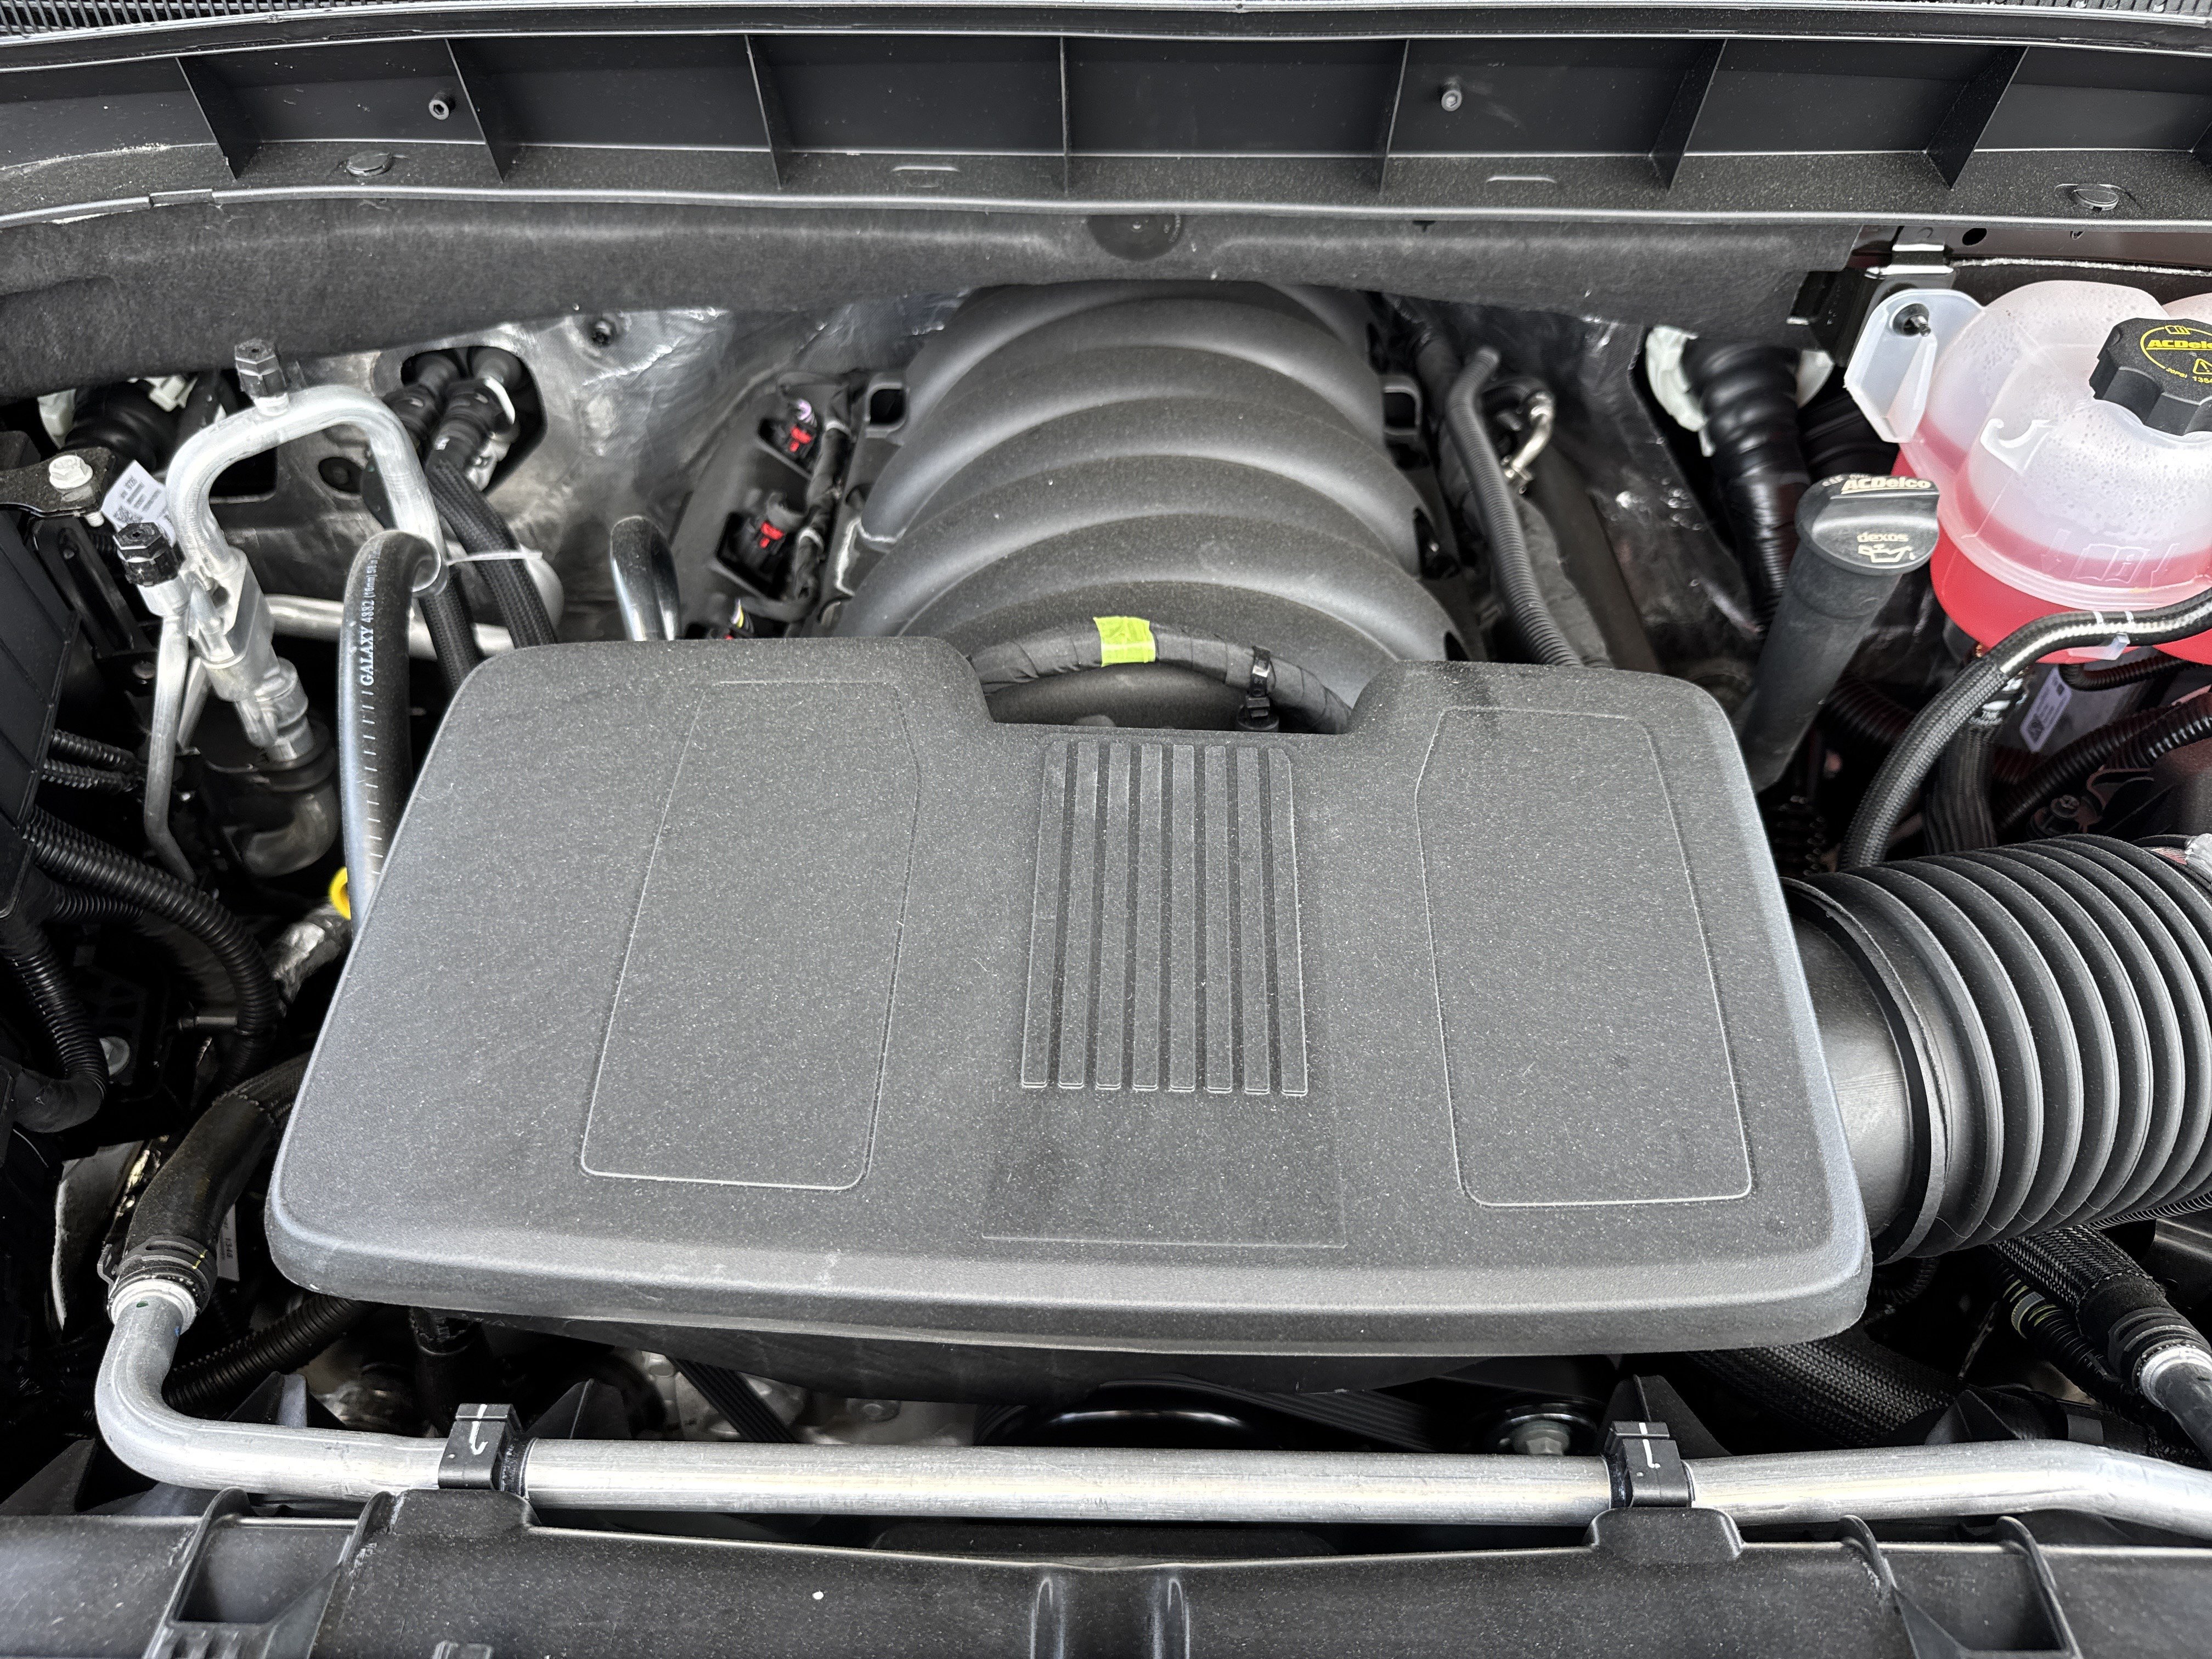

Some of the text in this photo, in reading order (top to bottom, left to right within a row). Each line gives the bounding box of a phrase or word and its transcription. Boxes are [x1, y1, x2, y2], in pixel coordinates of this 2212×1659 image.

[1841, 476, 1932, 492] ACDelco
[1857, 531, 1909, 543] dexos
[360, 625, 374, 686] GALAXY
